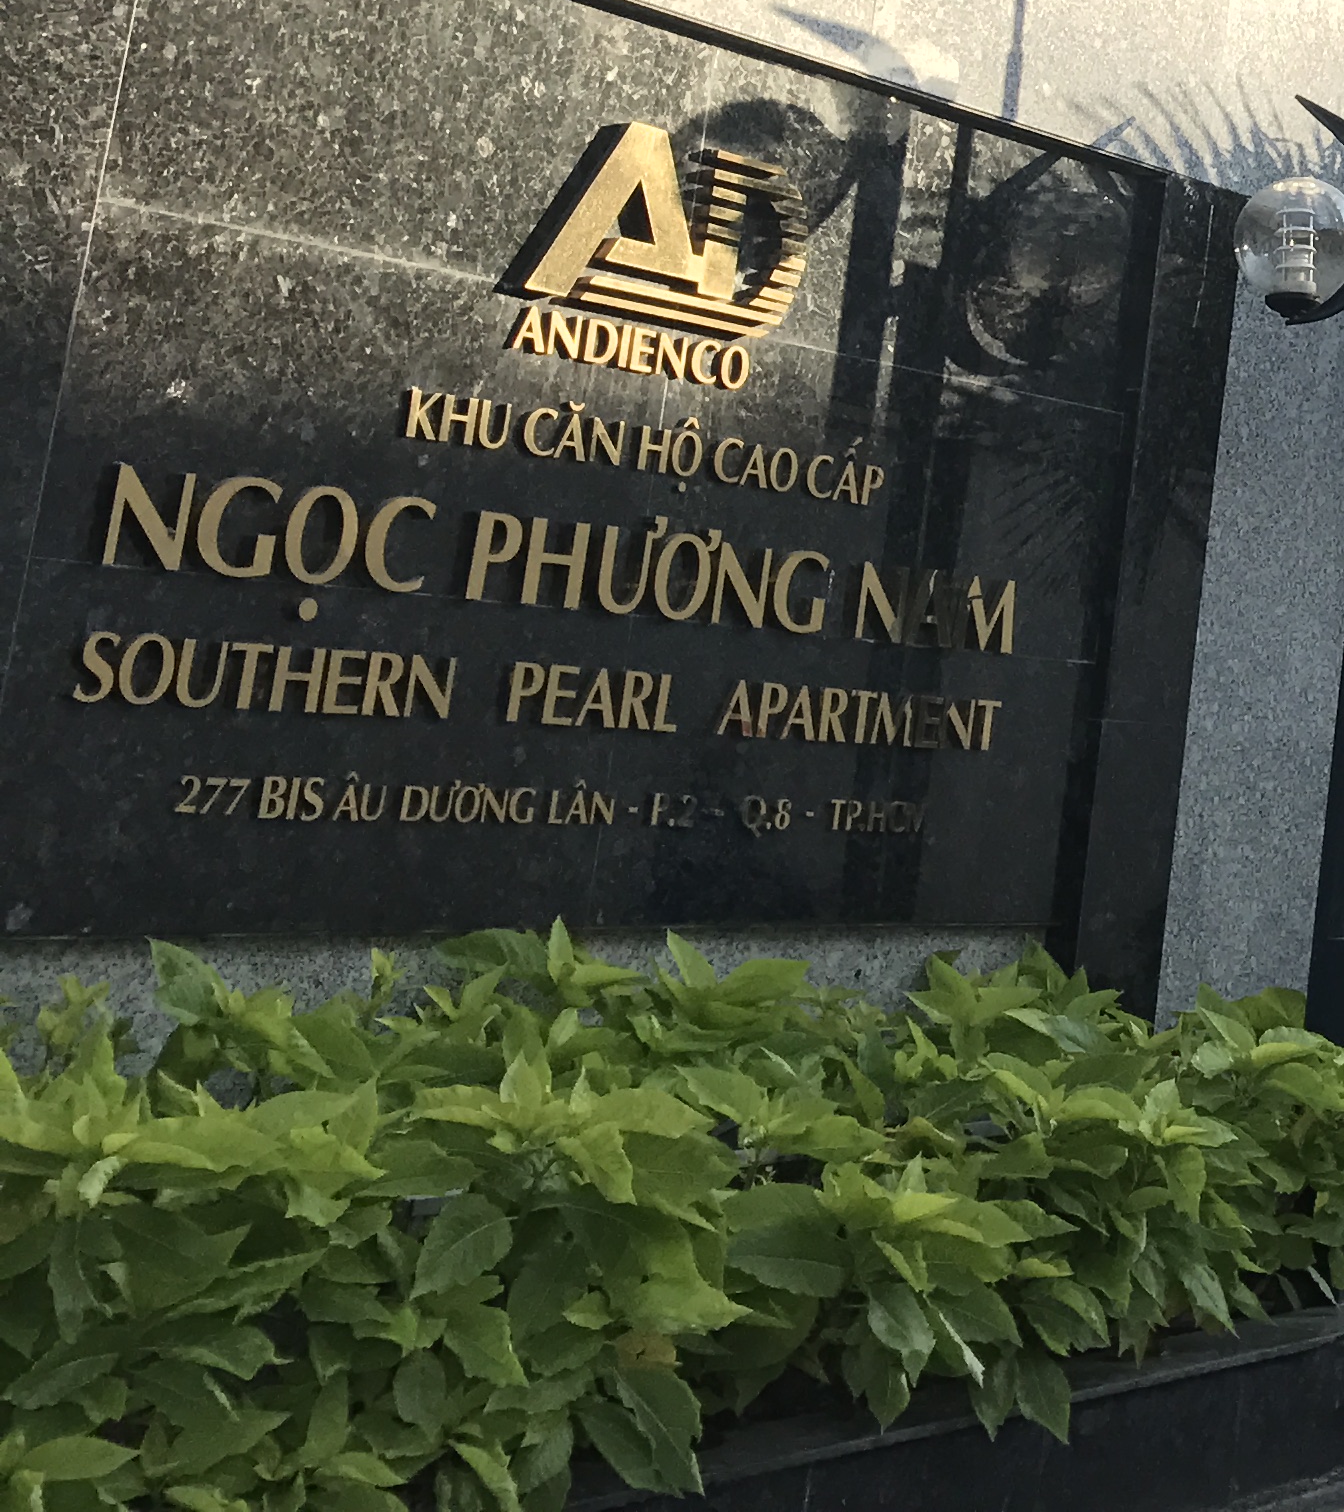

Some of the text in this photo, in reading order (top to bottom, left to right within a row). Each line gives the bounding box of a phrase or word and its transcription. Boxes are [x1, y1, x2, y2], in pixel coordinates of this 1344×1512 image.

[512, 305, 750, 390] ANDIENCO
[405, 386, 886, 507] KHU CĂN HỘ CAO CẤP
[102, 462, 1017, 655] NGỌC PHƯƠNG NAM
[72, 630, 1003, 751] SOUTHERN PEARL APARTMENT
[174, 774, 252, 816] 277
[257, 774, 326, 822] BIS
[332, 771, 388, 822] ÂU
[400, 779, 538, 826] DƯƠNG
[547, 778, 616, 826] LÂN
[741, 794, 793, 838] Q.8
